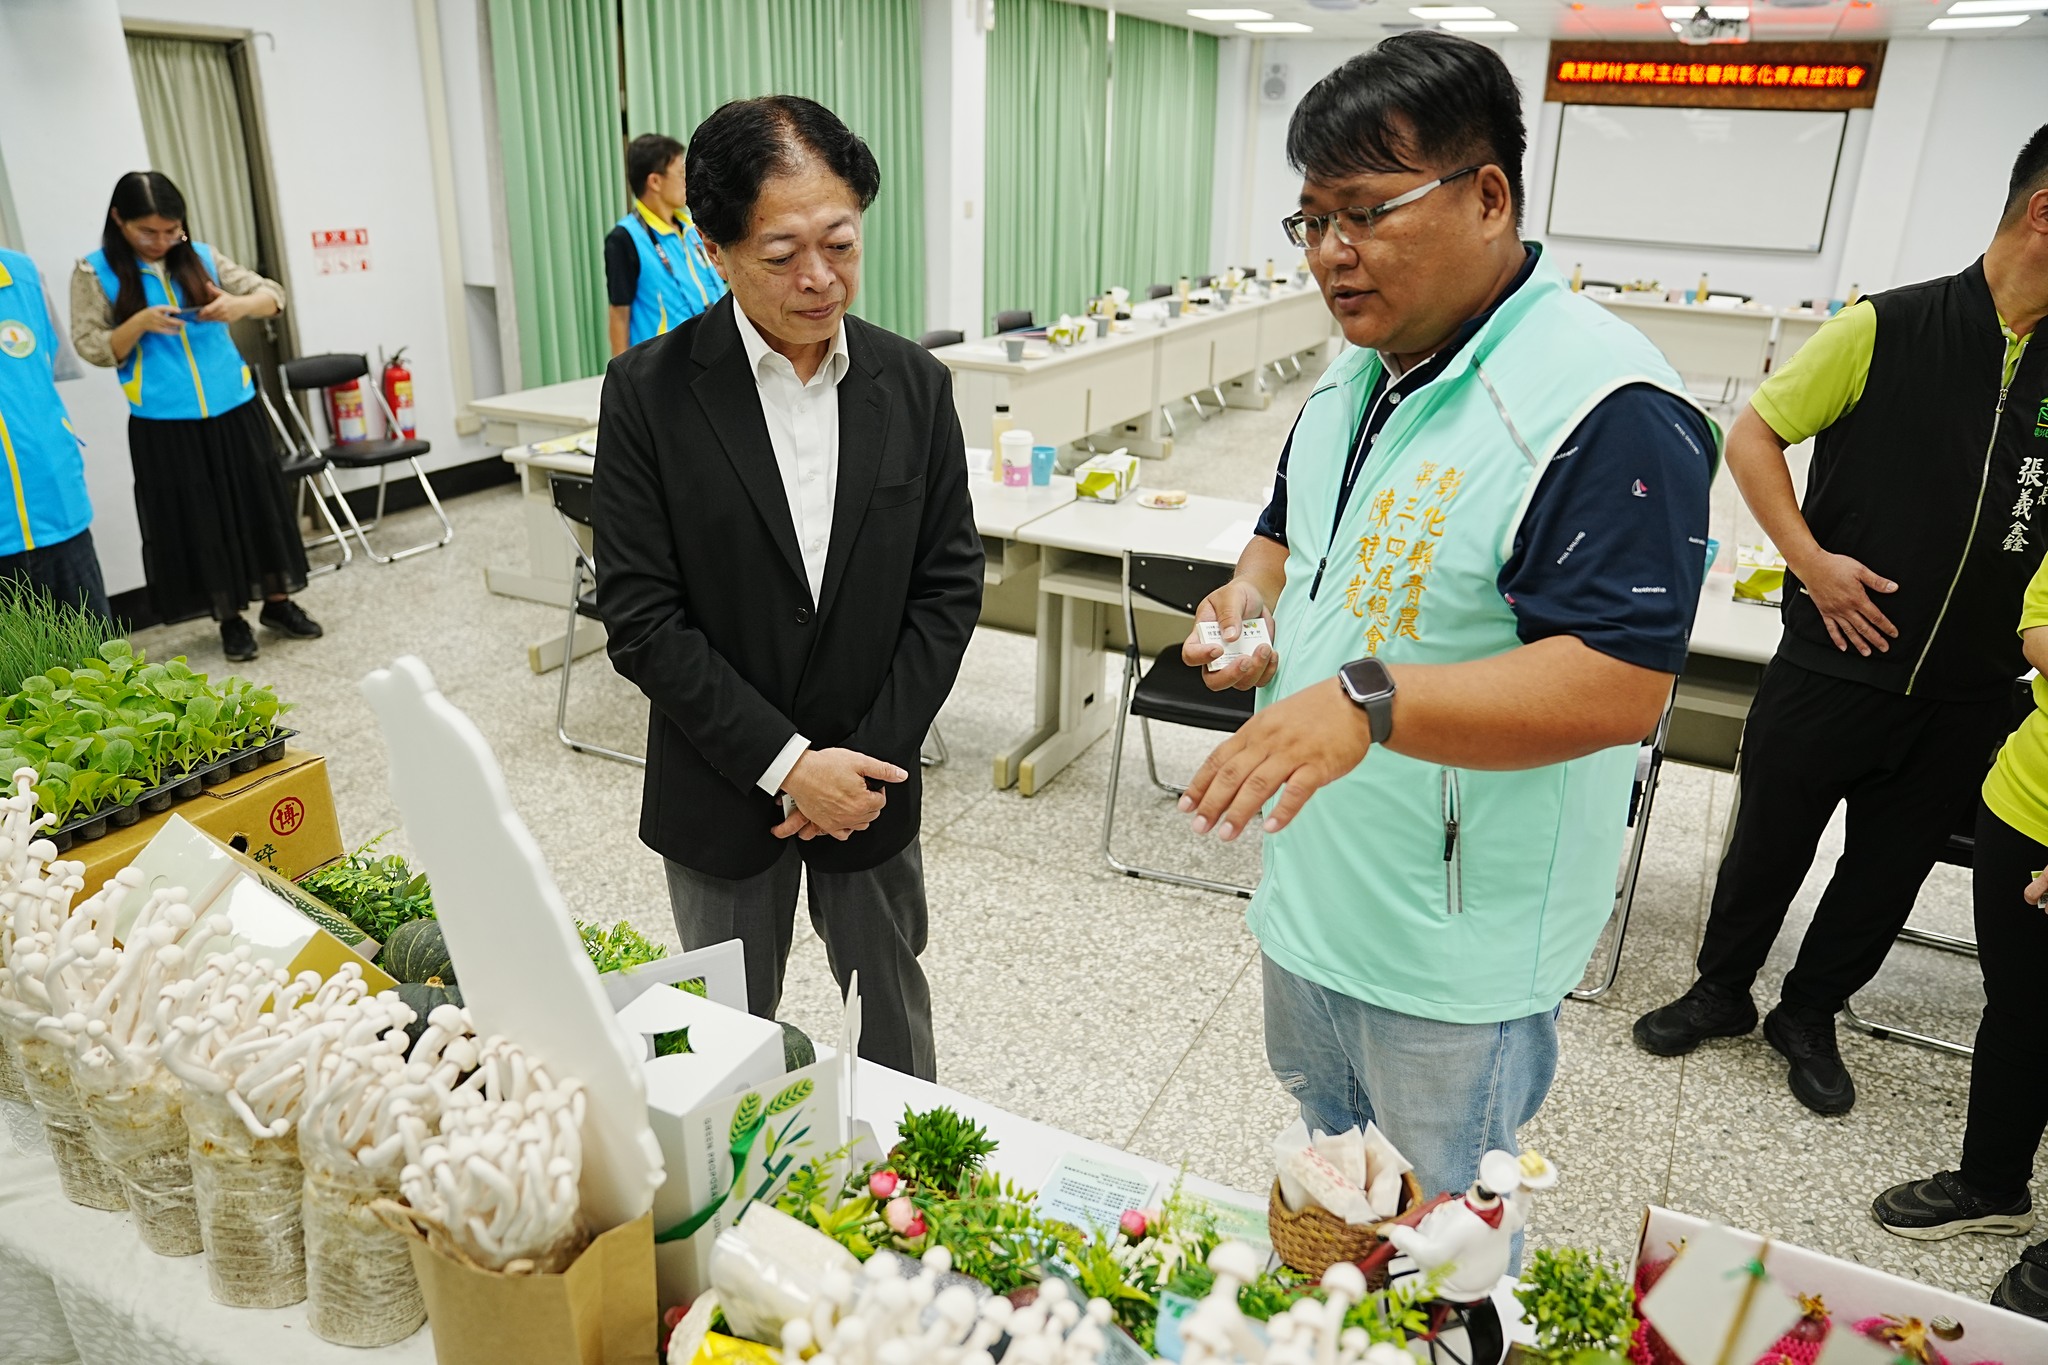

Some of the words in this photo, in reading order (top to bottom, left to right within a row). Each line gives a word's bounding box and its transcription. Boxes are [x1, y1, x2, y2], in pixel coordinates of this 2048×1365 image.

[1343, 488, 1395, 618] 陳建凱
[1363, 460, 1439, 659] 第三、四屆總會
[1392, 467, 1465, 641] 彰化縣青農
[2002, 457, 2045, 552] 張義鑫
[703, 1117, 714, 1150] GREEN
[707, 1151, 719, 1203] PROPOSAL
